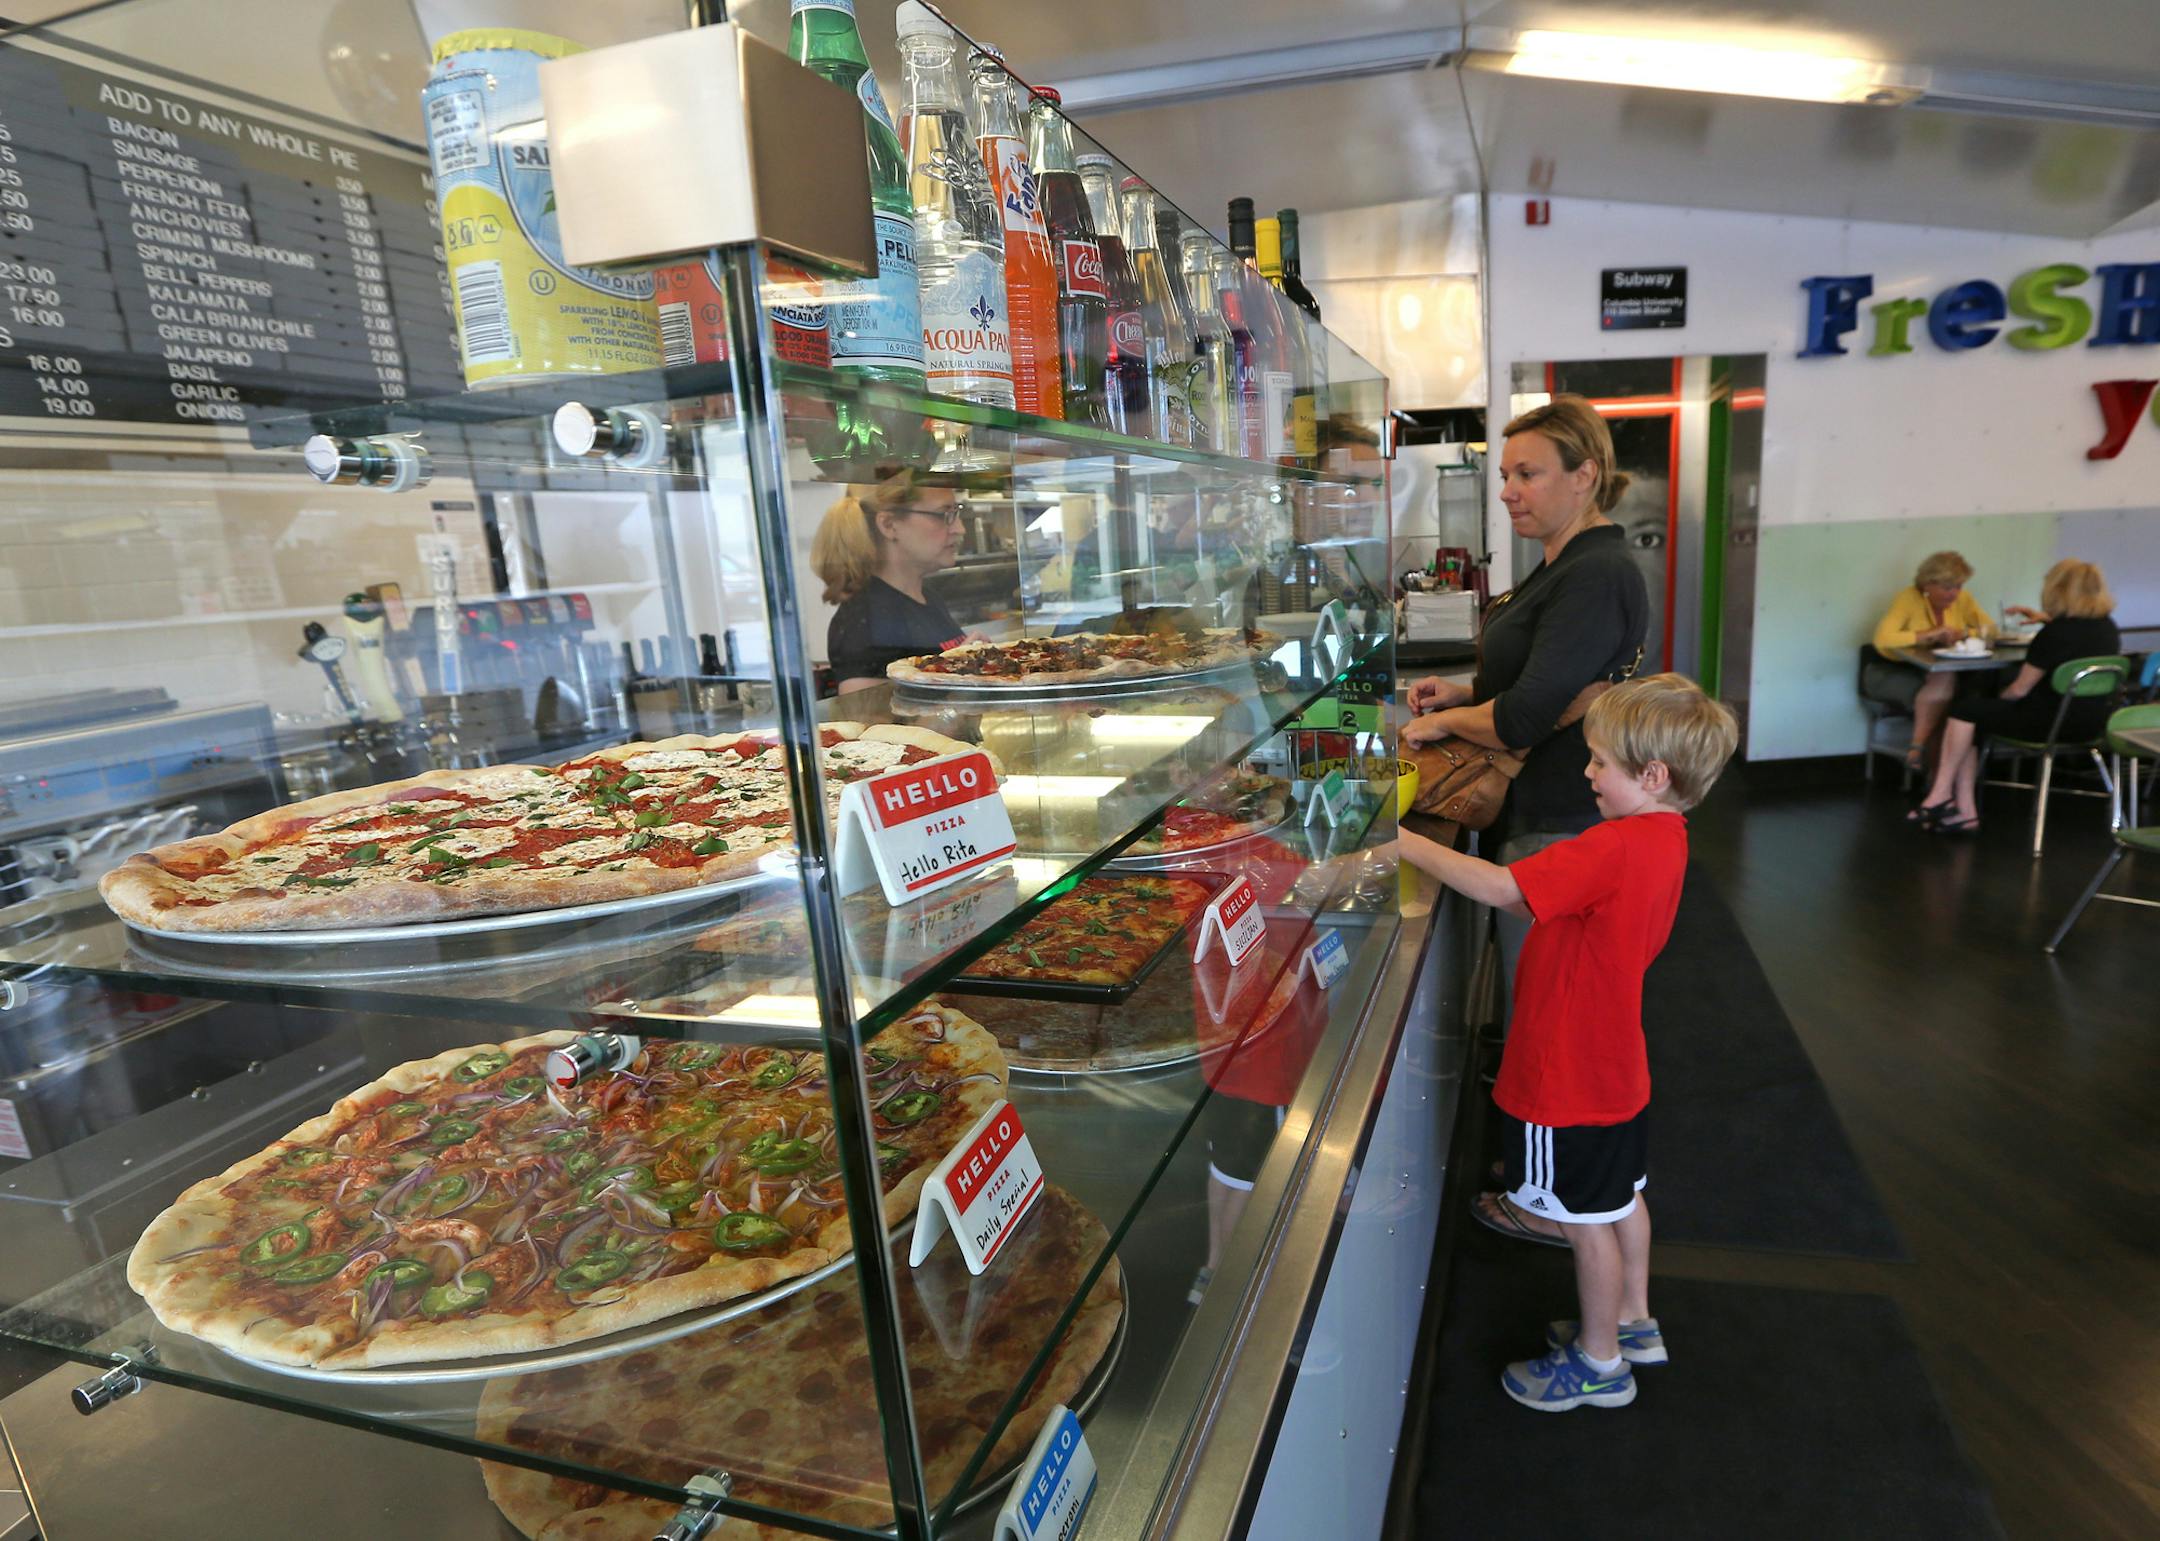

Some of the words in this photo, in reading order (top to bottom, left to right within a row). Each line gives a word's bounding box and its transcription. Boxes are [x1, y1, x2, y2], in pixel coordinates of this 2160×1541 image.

[101, 83, 153, 115] ADD
[155, 98, 192, 126] TO
[198, 110, 242, 140] ANY
[247, 123, 322, 162] WHOLE
[329, 146, 360, 172] PIE
[107, 116, 180, 149] BACON
[112, 139, 201, 174] SAUSAGE
[116, 159, 224, 198] PEPPERONI
[120, 180, 201, 213] FRENCH
[206, 199, 251, 222] FETA
[130, 202, 245, 239] ANCHOVIES
[132, 222, 206, 250] CRIMINI
[210, 237, 316, 270] MUSHROOMS
[136, 243, 217, 272] SPINACH
[142, 262, 195, 286] BELL
[197, 271, 273, 298] PEPPERS
[1614, 272, 1674, 289] Subway
[4, 285, 61, 307] 17.50
[147, 283, 250, 313] KALAMATA
[10, 306, 65, 328] 16.00
[266, 318, 317, 340] CHILE
[157, 323, 223, 346] GREEN
[226, 331, 290, 353] OLIVES
[923, 328, 985, 355] ACQUA
[27, 354, 82, 374] 16.00
[163, 344, 253, 368] JALAPENO
[930, 359, 974, 370] NATURAL
[977, 360, 1004, 371] SPRING
[36, 376, 90, 396] 14.00
[167, 362, 222, 383] BASIL
[43, 397, 96, 416] 19.00
[170, 382, 241, 402] GARLIC
[175, 402, 246, 422] ONIONS
[883, 767, 977, 811] HELLO
[925, 815, 966, 837] PIZZA
[899, 855, 939, 883] Hello
[943, 840, 977, 865] Rita
[1225, 888, 1251, 919] HELLO
[957, 1121, 1011, 1194] HELLO
[986, 1169, 1011, 1202] PIZZA
[976, 1215, 1002, 1251] Daily
[1027, 1430, 1071, 1517] HELLO
[1051, 1478, 1071, 1516] PIZZA
